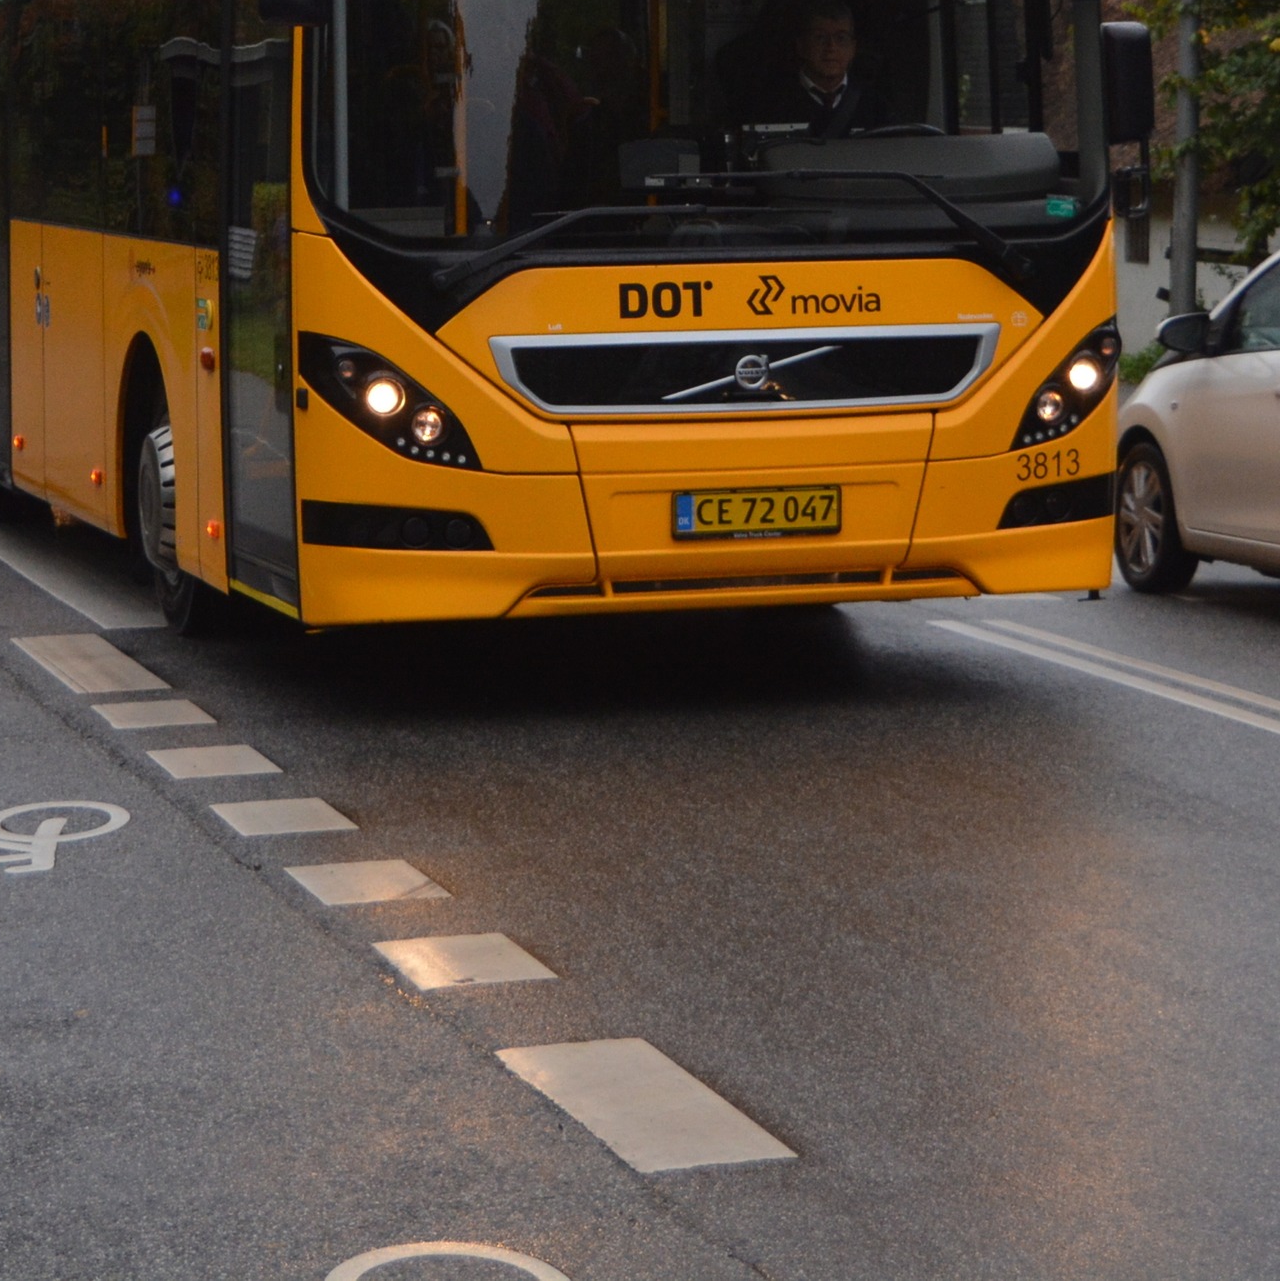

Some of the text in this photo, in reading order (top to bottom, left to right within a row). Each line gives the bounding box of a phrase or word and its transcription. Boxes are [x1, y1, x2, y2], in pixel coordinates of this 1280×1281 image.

[619, 280, 704, 318] DOT
[791, 286, 881, 314] movia
[1016, 449, 1080, 482] 3813
[678, 516, 690, 526] DK
[696, 494, 835, 526] CE 72 047
